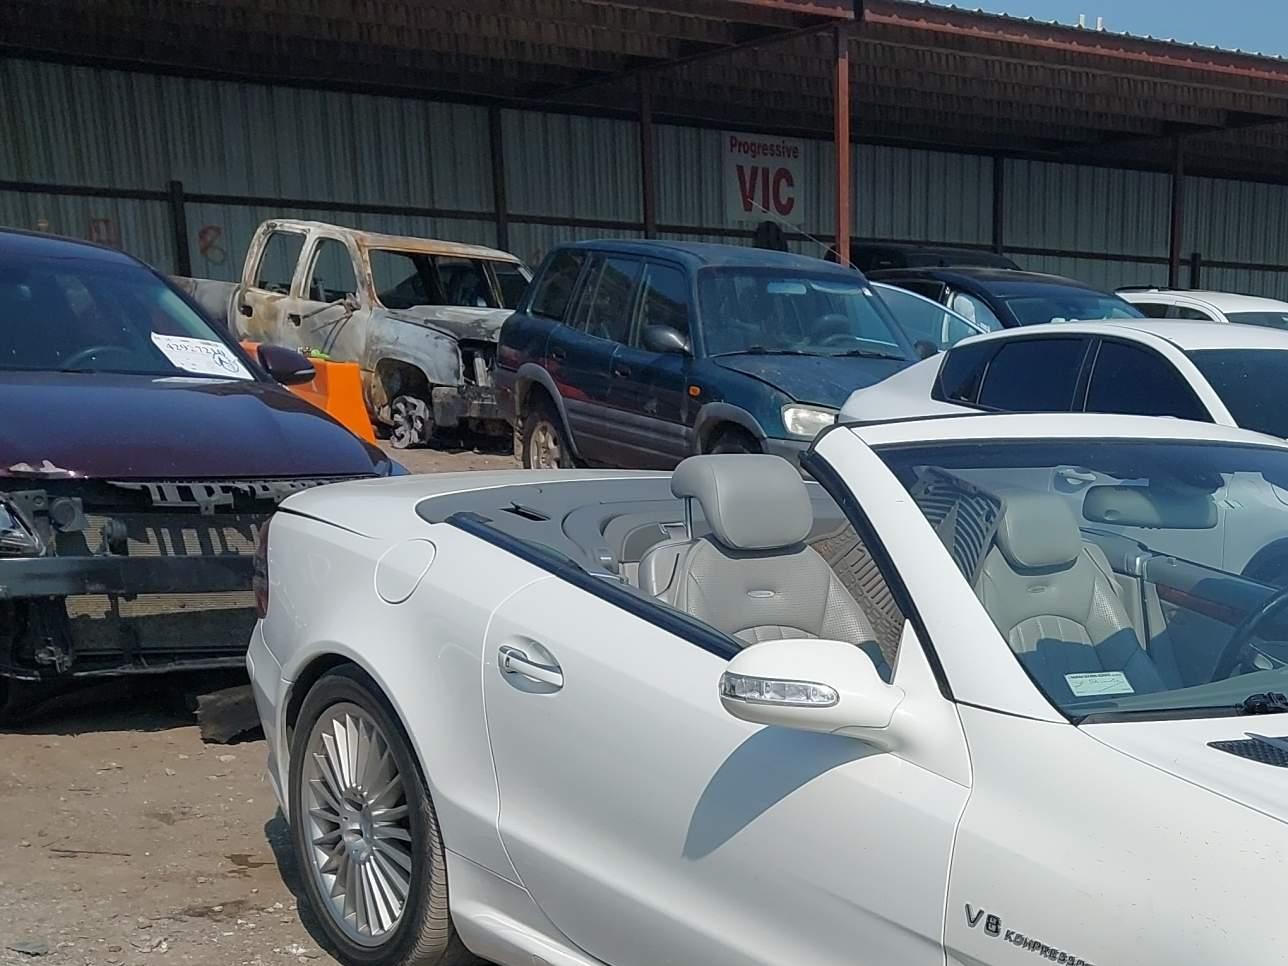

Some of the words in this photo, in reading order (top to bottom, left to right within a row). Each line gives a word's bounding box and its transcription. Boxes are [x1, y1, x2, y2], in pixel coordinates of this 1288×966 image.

[729, 135, 799, 159] Progressive
[736, 164, 795, 216] VIC
[964, 903, 1002, 938] V8
